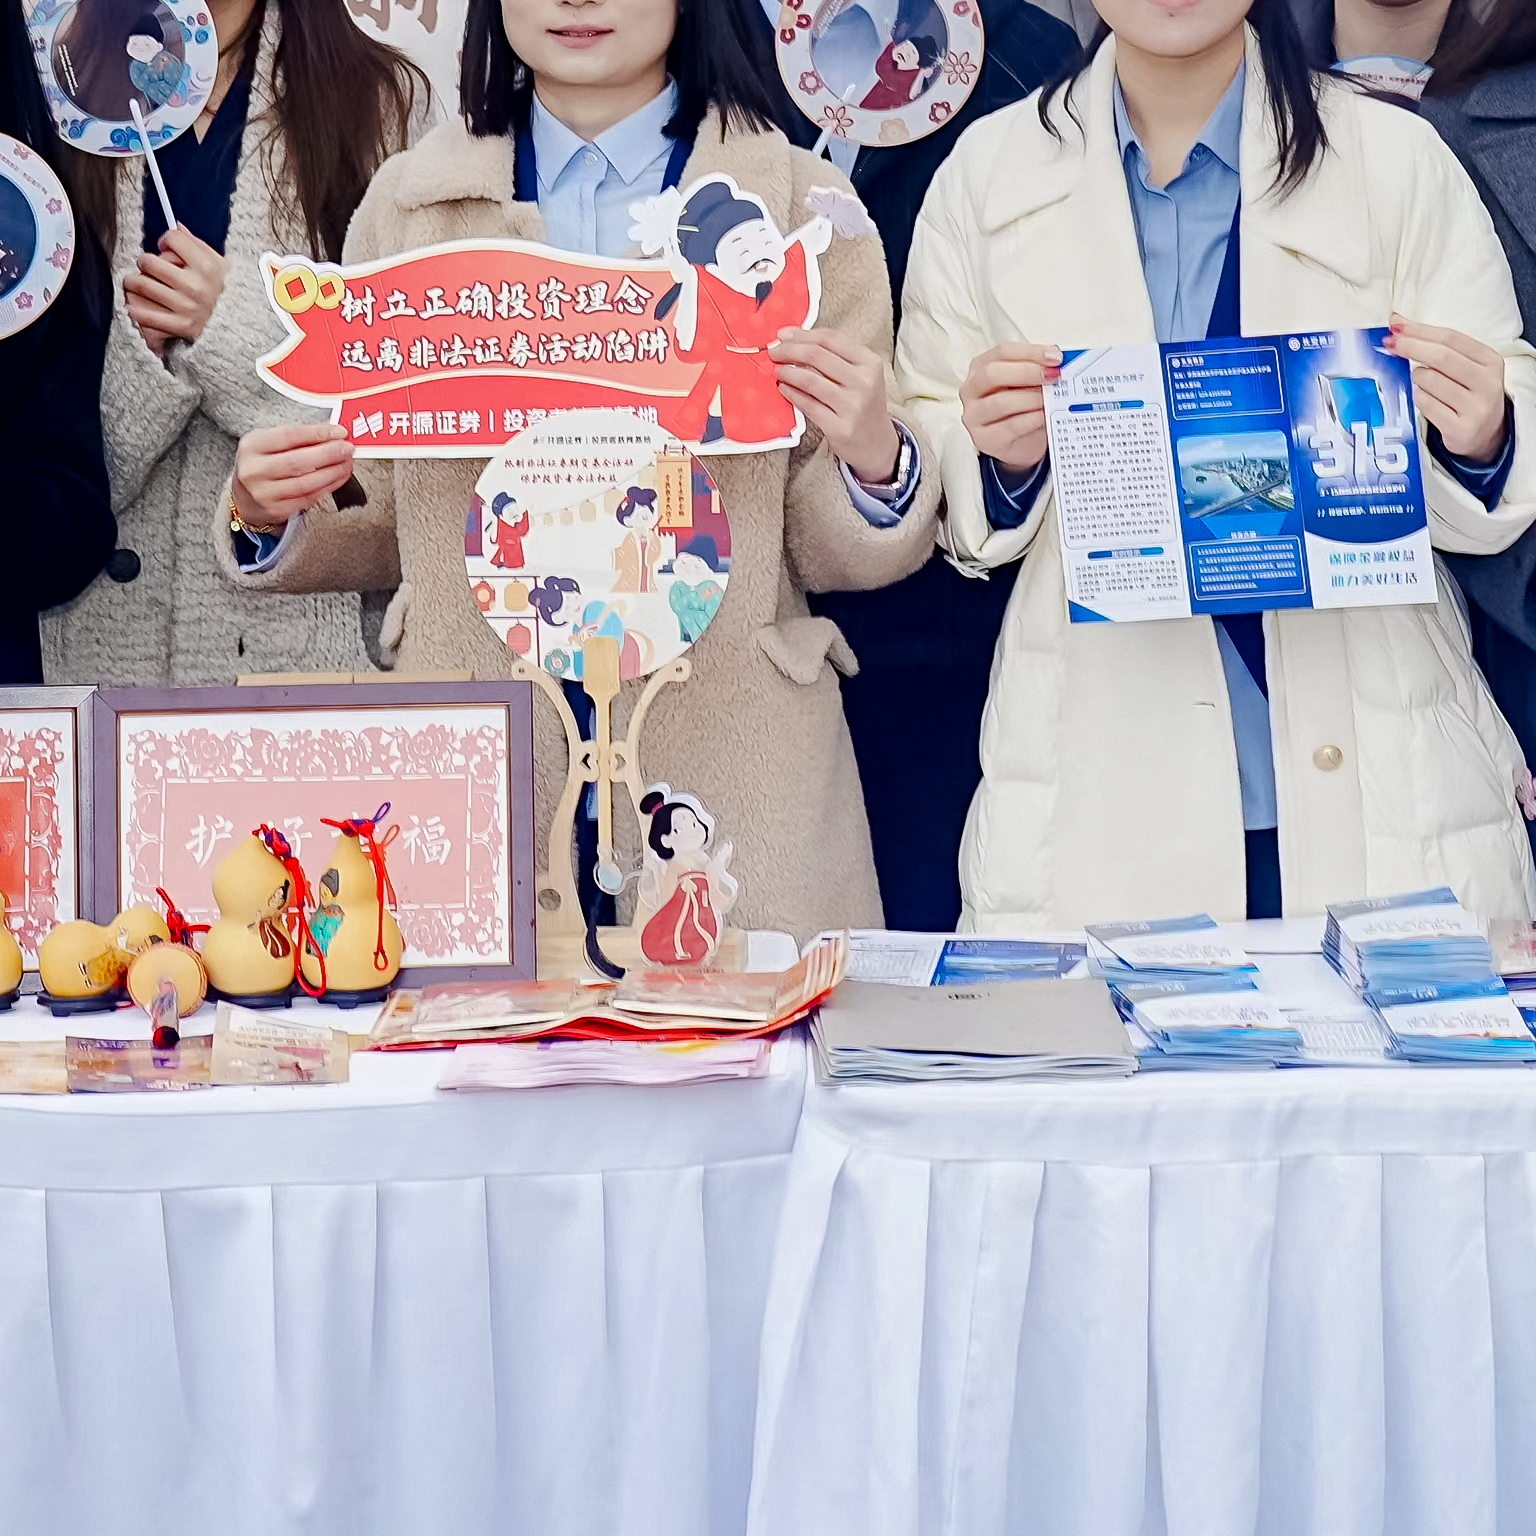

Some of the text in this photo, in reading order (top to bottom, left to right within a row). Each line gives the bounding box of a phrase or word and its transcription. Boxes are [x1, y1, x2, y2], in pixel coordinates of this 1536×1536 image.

[339, 276, 656, 326] 树立正确投资理念
[341, 330, 670, 372] 远离非法证券活动陷阱
[1310, 422, 1410, 480] 315
